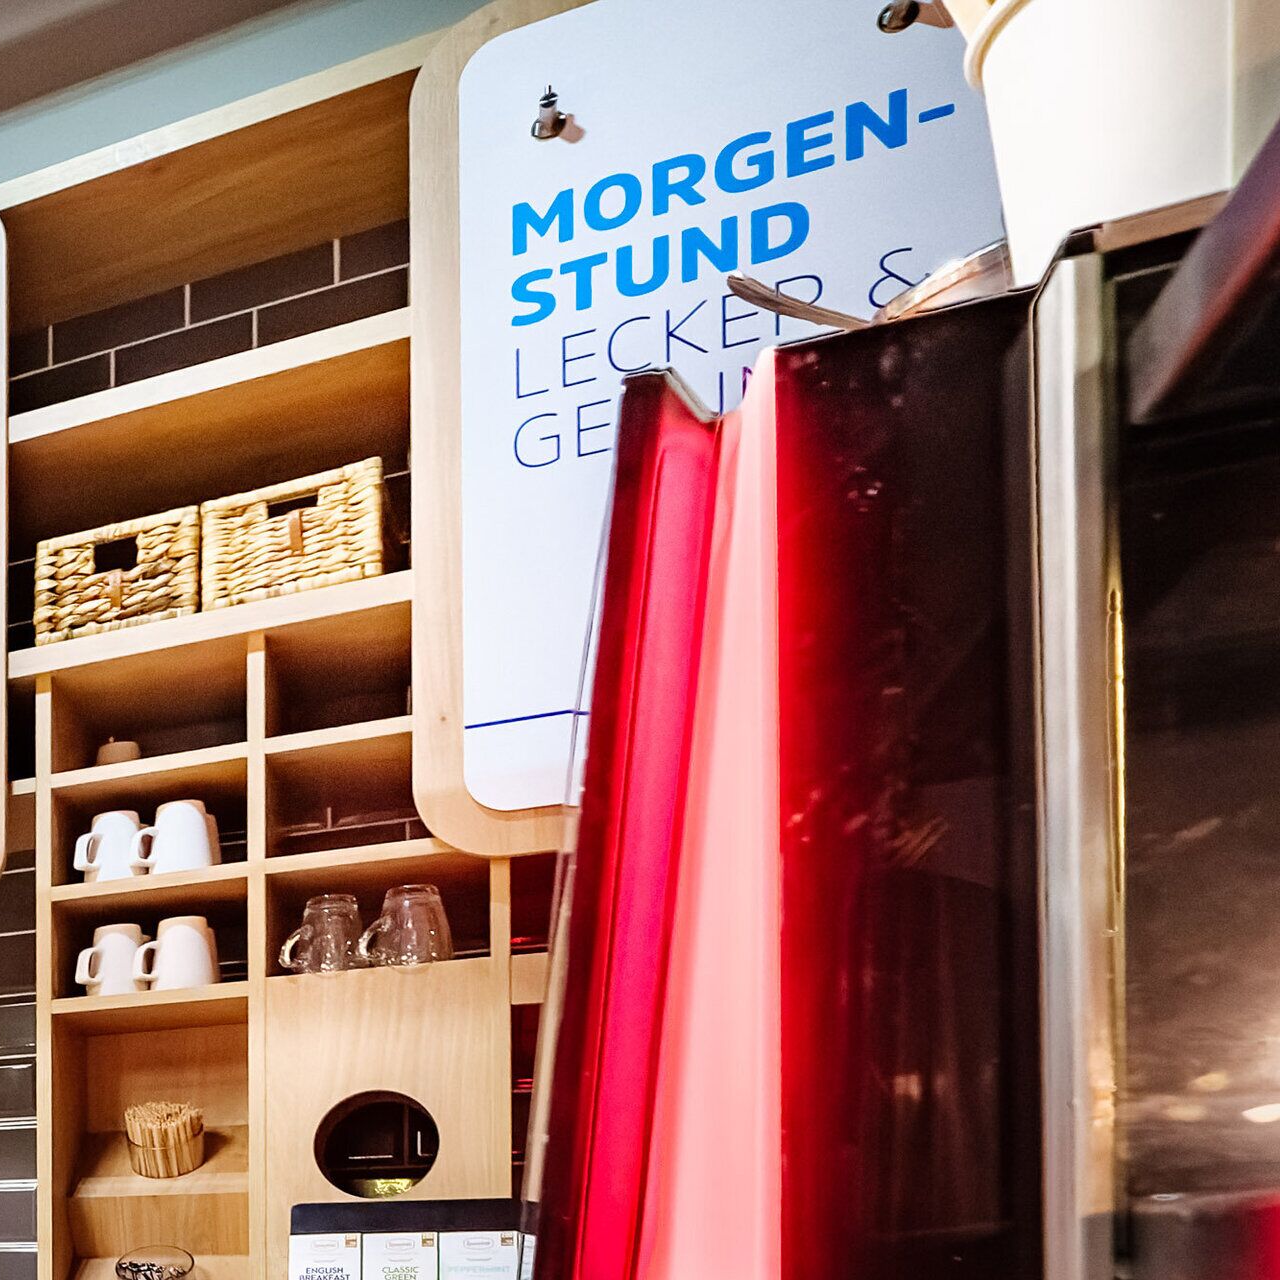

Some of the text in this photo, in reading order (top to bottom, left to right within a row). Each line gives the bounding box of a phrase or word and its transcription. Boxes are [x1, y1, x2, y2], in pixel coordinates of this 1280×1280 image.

[511, 88, 956, 257] MORGEN-
[511, 201, 810, 327] STUND
[381, 1266, 420, 1274] CLASSIC
